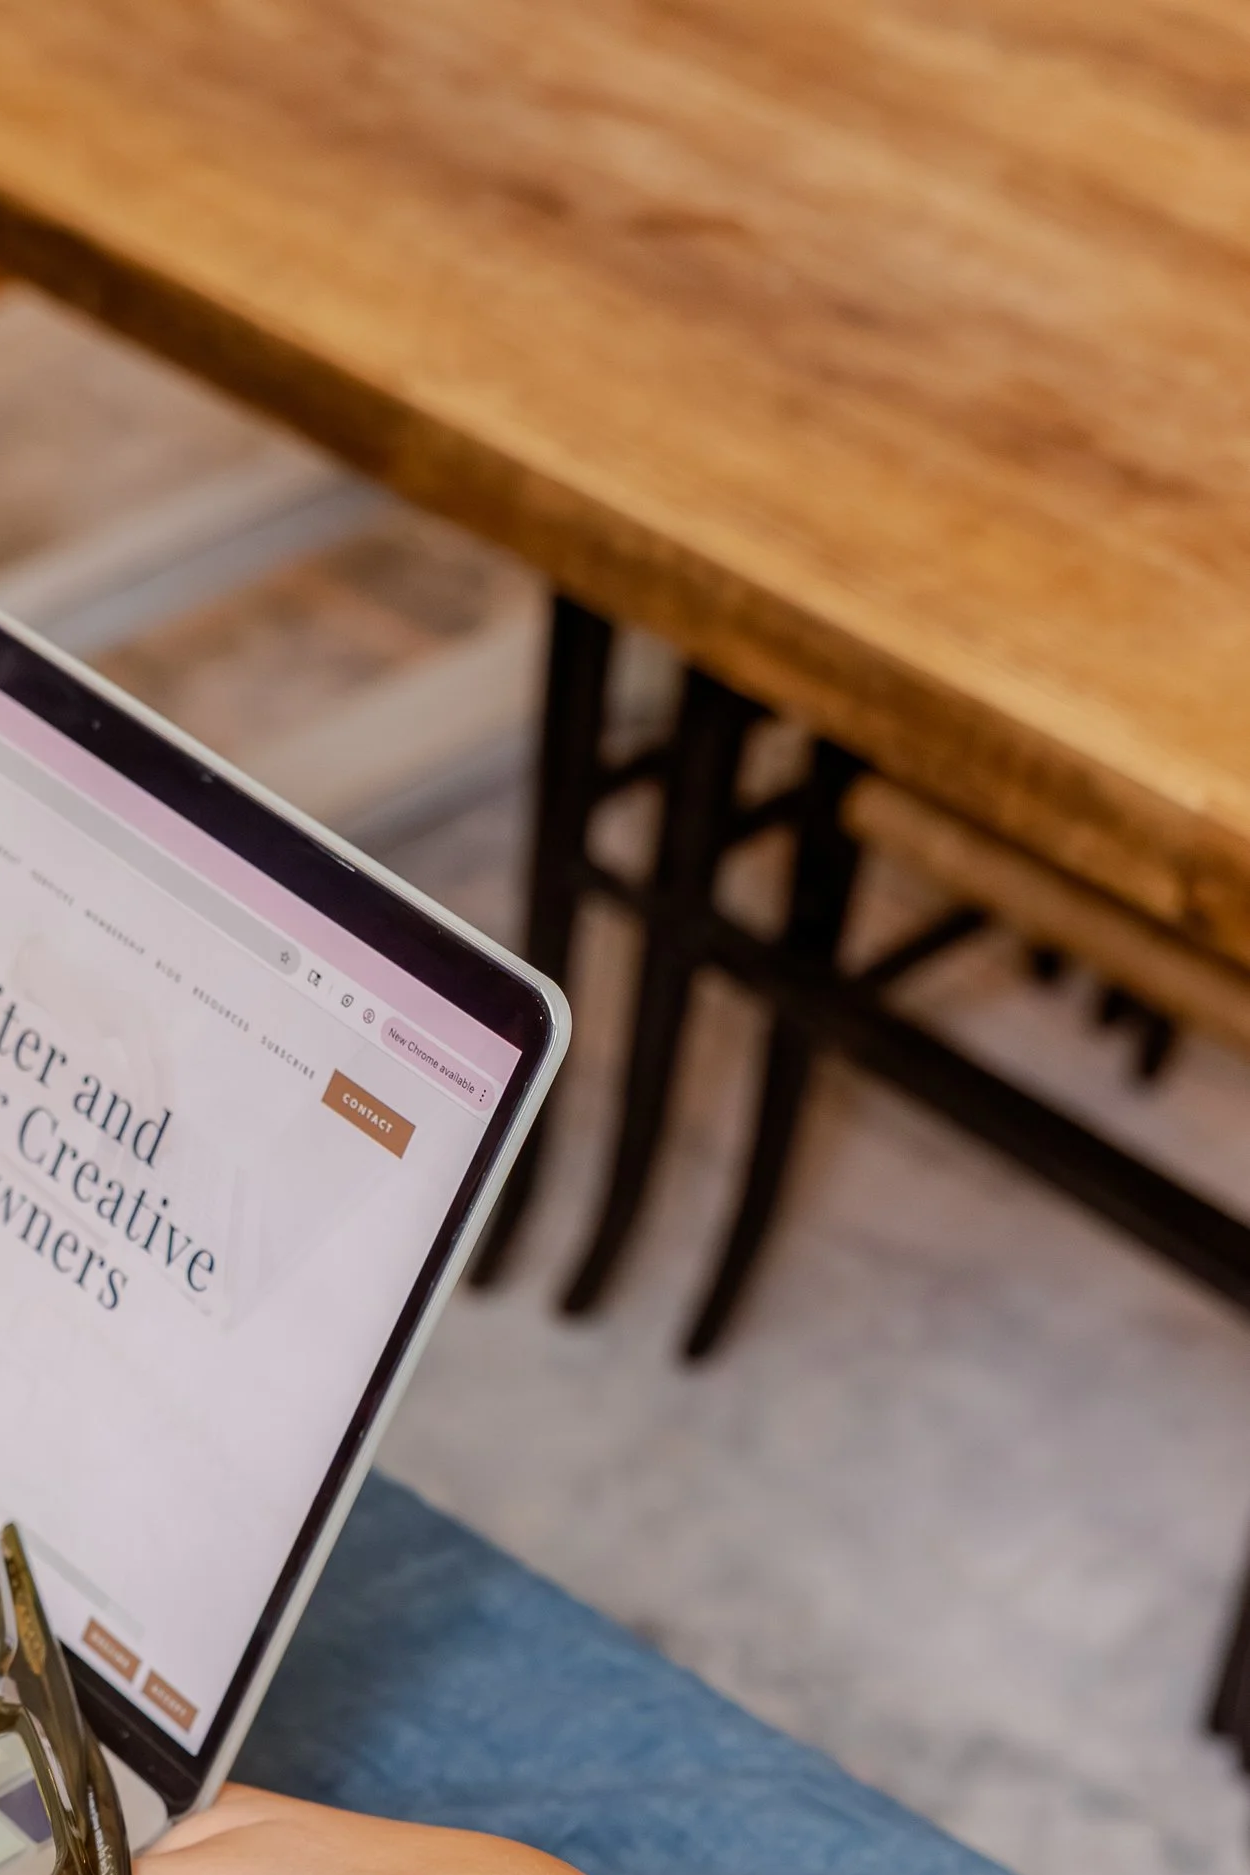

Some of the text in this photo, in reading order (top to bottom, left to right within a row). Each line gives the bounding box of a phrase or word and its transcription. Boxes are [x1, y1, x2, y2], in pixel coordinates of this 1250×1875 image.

[155, 959, 181, 984] BLOG
[192, 985, 249, 1033] RESOURCES
[260, 1034, 316, 1081] SUBSCRIBE
[388, 1028, 475, 1094] New Chrome available
[72, 1073, 173, 1169] and
[341, 1092, 393, 1134] CONTACT
[17, 1105, 216, 1294] Creative
